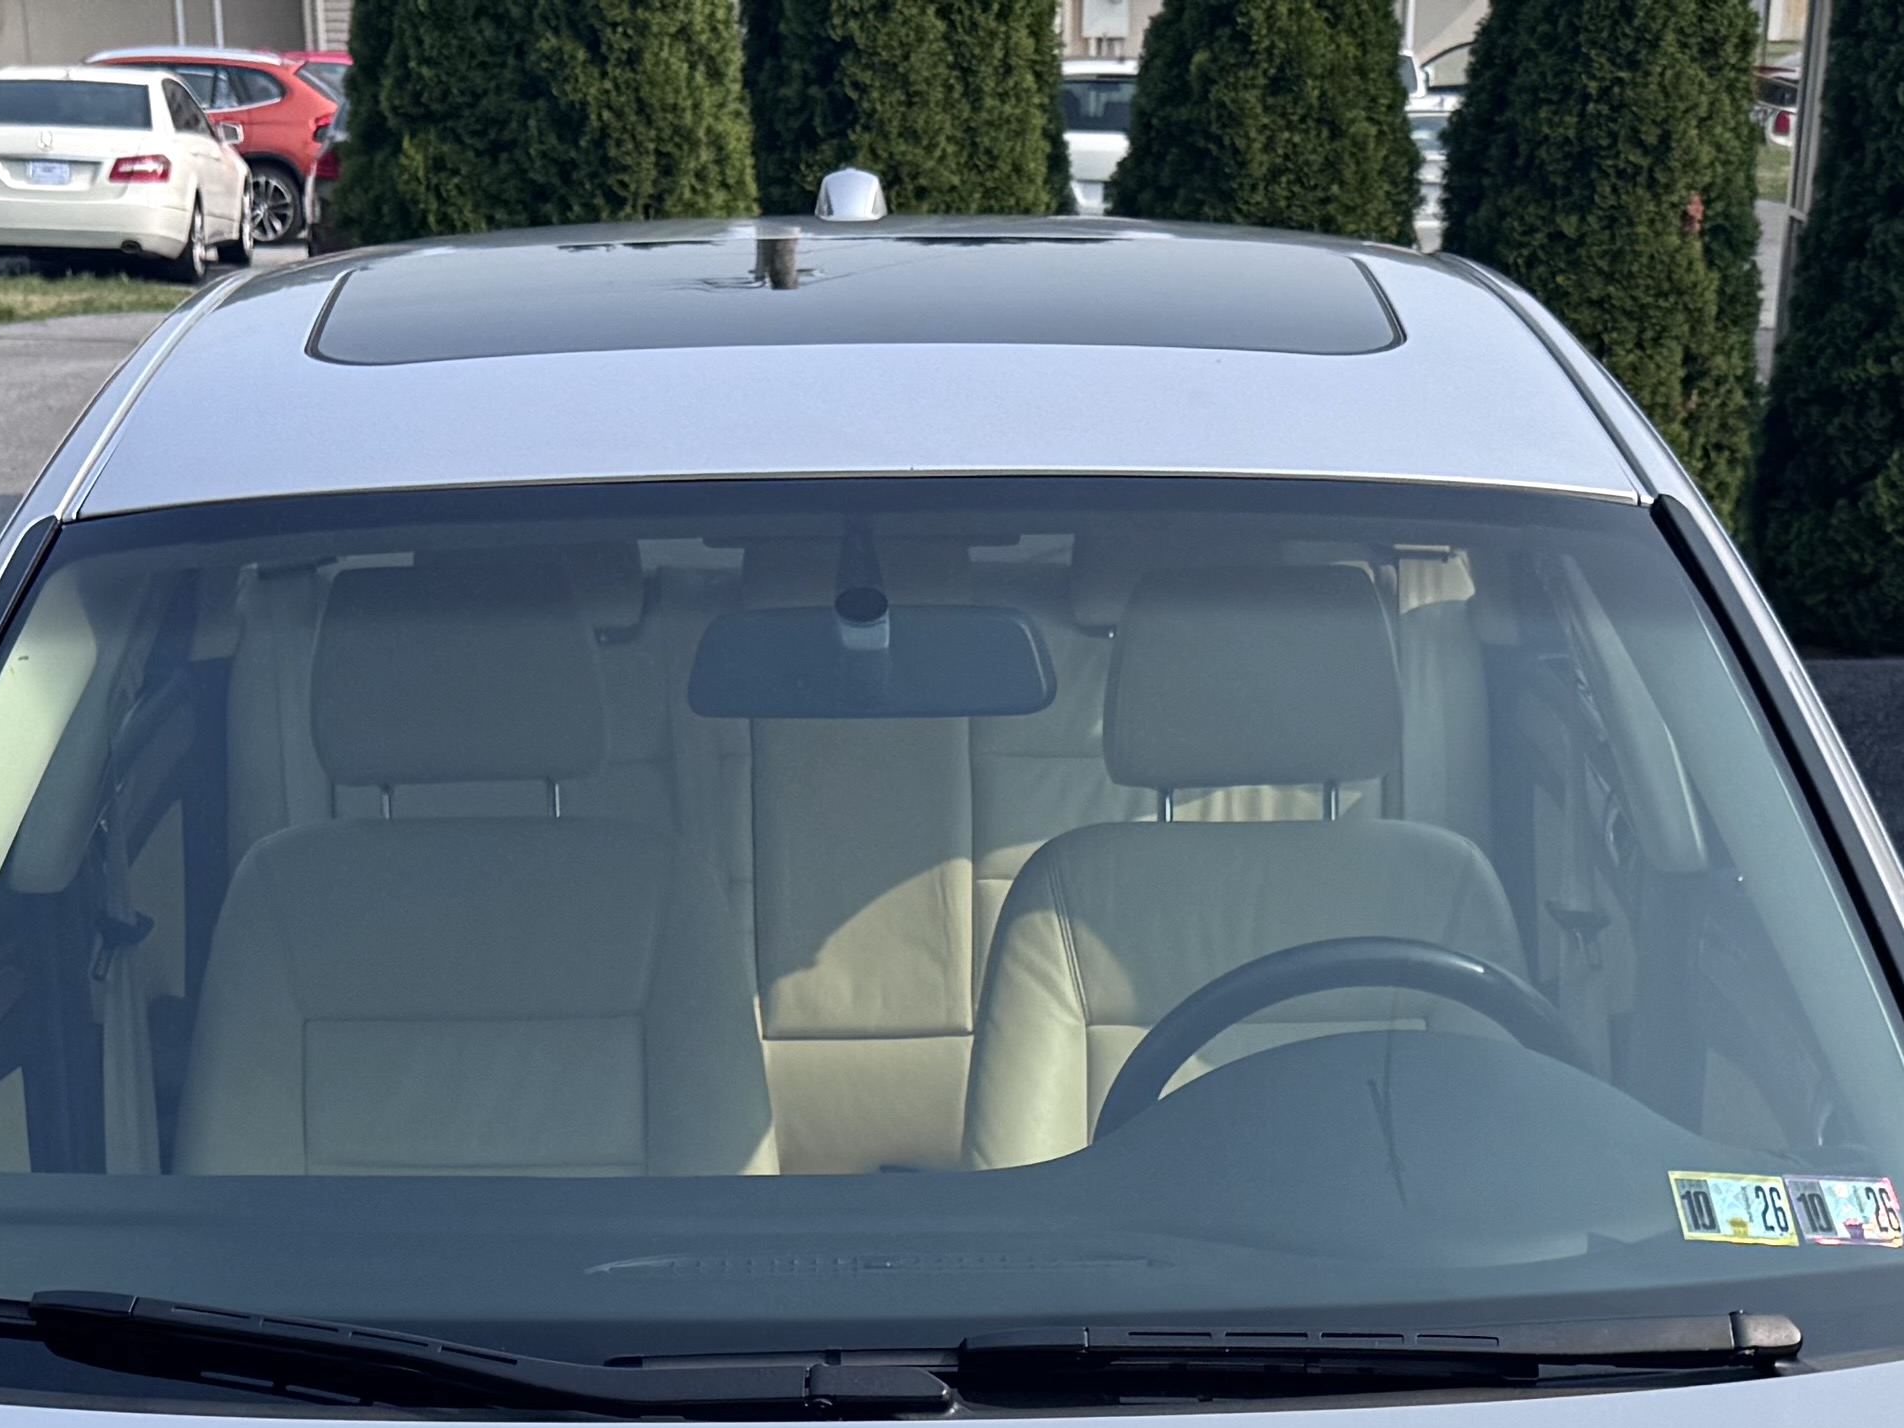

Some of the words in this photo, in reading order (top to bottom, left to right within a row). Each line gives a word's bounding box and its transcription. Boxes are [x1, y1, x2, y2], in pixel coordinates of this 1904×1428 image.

[1680, 1190, 1717, 1231] 10
[1754, 1185, 1789, 1233] 26
[1797, 1193, 1834, 1233] 10
[1864, 1187, 1902, 1233] 26
